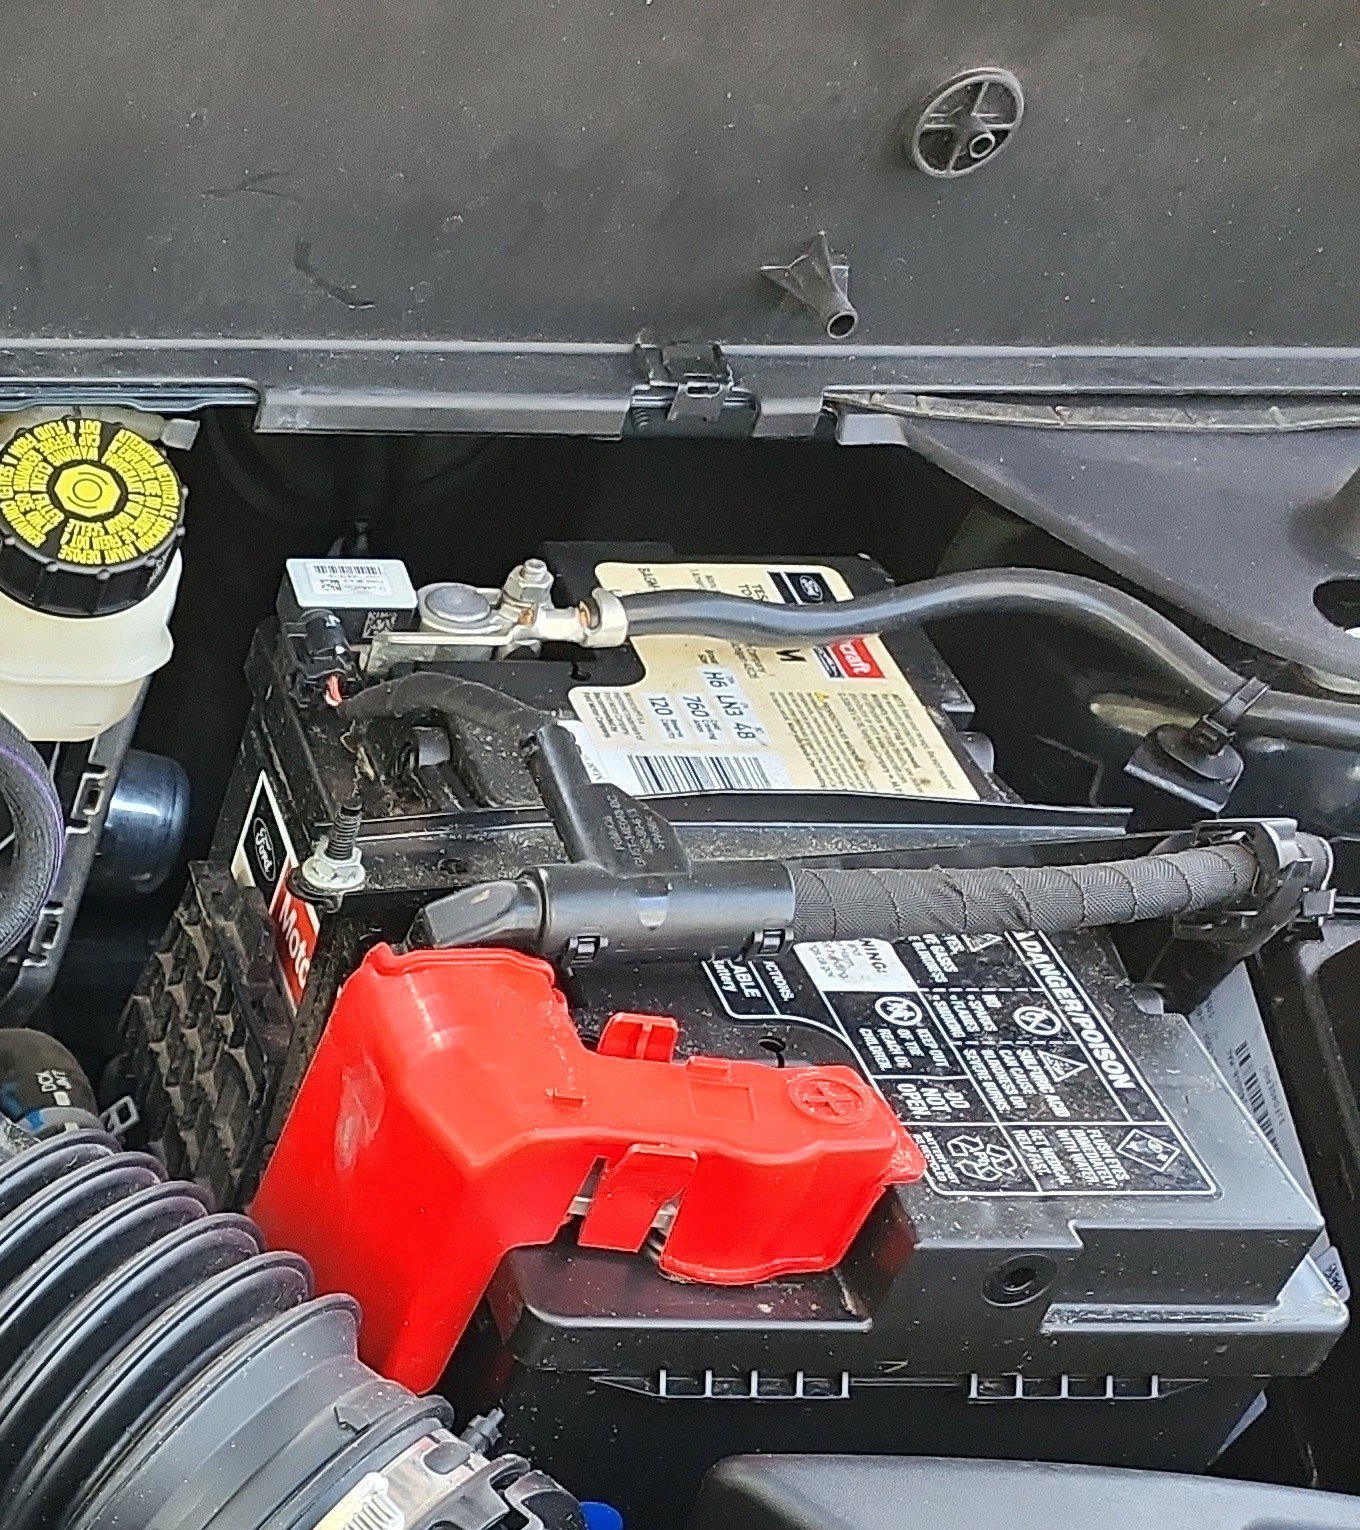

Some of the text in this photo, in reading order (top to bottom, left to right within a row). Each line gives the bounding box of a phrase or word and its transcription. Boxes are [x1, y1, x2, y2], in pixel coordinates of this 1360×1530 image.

[33, 421, 67, 441] FLUID
[79, 420, 101, 434] DOT
[79, 434, 100, 446] CAP
[8, 433, 37, 459] FROM
[36, 434, 76, 452] BEFORE
[48, 444, 98, 466] WARNING
[30, 461, 54, 491] CLEAN
[58, 545, 101, 564] DEPOSE
[72, 535, 91, 550] DOT
[104, 542, 138, 564] AVANT
[646, 696, 674, 715] 120
[681, 696, 710, 717] 760
[702, 671, 757, 738] H6 LN3 48
[982, 994, 1002, 1007] NO
[951, 1001, 981, 1032] FLAMES
[1022, 942, 1137, 1088] DANGER/POISON
[877, 1028, 904, 1054] REACH
[896, 1028, 925, 1056] OF THE
[915, 1028, 950, 1067] KEEP OUT
[962, 1049, 992, 1080] SEVERE
[998, 1049, 1038, 1094] CAN CAUSE
[980, 1049, 1030, 1109] BLINDNESS OR
[1016, 1049, 1071, 1117] SULFURIC ACID
[894, 1083, 934, 1119] OPEN.
[920, 1088, 952, 1112] NOT
[944, 1092, 971, 1109] DO
[1011, 1130, 1052, 1175] HELP FAST.
[1055, 1129, 1080, 1151] WITH
[1087, 1130, 1115, 1157] FLUSH
[1028, 1130, 1074, 1185] GET MEDICAL
